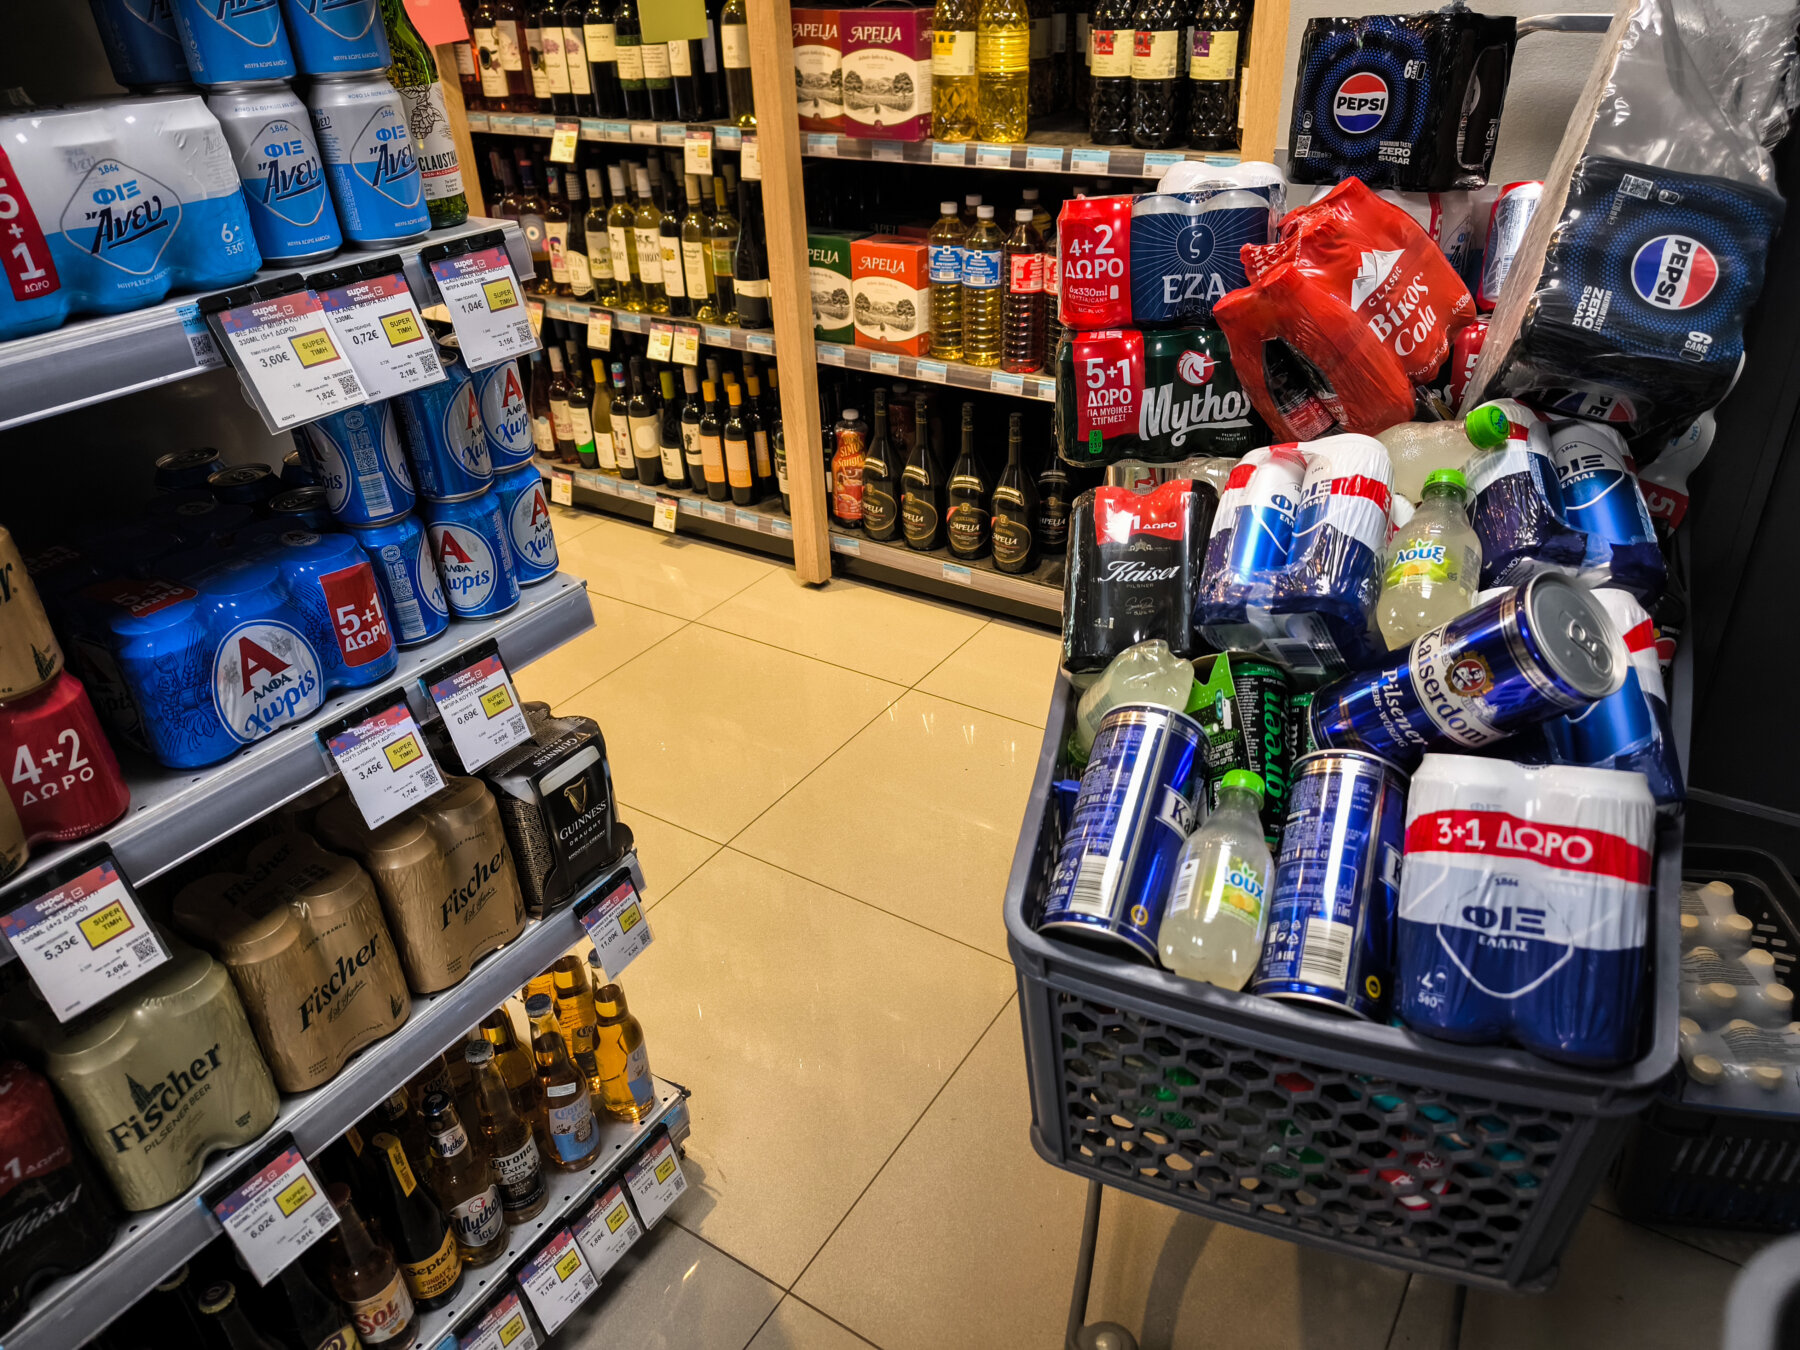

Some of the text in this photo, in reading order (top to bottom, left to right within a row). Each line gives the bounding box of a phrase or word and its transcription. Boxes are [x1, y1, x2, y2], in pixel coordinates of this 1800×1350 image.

[793, 23, 839, 43] APELIA
[848, 26, 901, 44] APELIA
[1403, 59, 1414, 79] 6
[1336, 96, 1386, 111] PEPSI
[375, 125, 407, 142] ΦΙΞ
[264, 140, 304, 158] ΦΙΞ
[1379, 147, 1411, 157] ZERO
[1378, 154, 1410, 165] SUGAR
[92, 179, 141, 205] ΦΙΞ
[1069, 223, 1115, 260] 4+2
[808, 248, 840, 268] PELIA
[857, 255, 906, 276] APELIA
[1065, 258, 1124, 281] ΔΩΡΟ
[1653, 239, 1692, 306] PEPSI
[346, 285, 370, 299] super
[493, 289, 512, 299] SUPER
[1368, 264, 1403, 309] CLASSIC
[251, 304, 278, 318] super
[461, 300, 485, 315] 1,04€
[1571, 285, 1592, 327] SUGAR
[1581, 286, 1604, 330] ZERO
[389, 317, 411, 330] SUPER
[397, 326, 413, 337] ΤΙΜΗ
[1393, 304, 1438, 358] Cola
[239, 335, 260, 347] 330ML
[301, 338, 326, 351] SUPER
[353, 331, 380, 347] 0,72€
[1684, 340, 1708, 355] CANS
[259, 351, 290, 369] 3,60€
[309, 347, 328, 359] ΤΙΜΗ
[399, 368, 418, 382] 2,18€
[1086, 357, 1131, 390] 5+1
[316, 388, 336, 402] 1,82€
[1087, 388, 1132, 409] ΔΩΡΟ
[1091, 414, 1126, 427] ΣΤΙΓΜΕΣ!
[1100, 405, 1133, 418] ΜΥΘΙΚΕΣ
[1138, 383, 1252, 448] Mythos
[1561, 470, 1597, 489] ΕΛΛΑΣ
[1142, 521, 1178, 532] ΔΩΡΟ
[1099, 560, 1182, 582] Kaiser
[336, 592, 382, 637] 5+1
[345, 619, 387, 654] ΔΩΡΟ
[253, 673, 293, 703] ΑΛΦΑ
[1415, 626, 1487, 745] Kaiserdom
[487, 690, 505, 703] SUPER
[457, 708, 480, 726] 0,69€
[1382, 668, 1428, 746] Pilsener
[392, 740, 413, 756] SUPER
[533, 738, 578, 767] GUINNESS
[1263, 690, 1284, 799] green
[11, 728, 89, 787] 4+2
[399, 749, 414, 761] ΤΙΜΗ
[358, 760, 384, 781] 3,45€
[22, 767, 95, 807] ΔΩΡΟ
[401, 785, 419, 799] 1,74€
[559, 800, 607, 841] GUINNESS
[569, 820, 602, 847] DRAUGHT
[1496, 821, 1594, 865] ΔΩΡΟ
[35, 892, 65, 912] super
[93, 906, 121, 927] SUPER
[101, 915, 123, 932] ΤΙΜΗ
[1462, 905, 1547, 936] ΦΙΞ
[43, 934, 79, 962] 5,33€
[1478, 934, 1529, 953] ΕΛΛΑΣ
[105, 959, 129, 979] 2,69€
[297, 933, 379, 1034] Fischer
[106, 1042, 223, 1155] Fischer
[144, 1082, 213, 1155] PILSENER BEER
[249, 1215, 276, 1240] 6,02€
[589, 1230, 605, 1249] 1,88€
[540, 1278, 558, 1298] 1,15€
